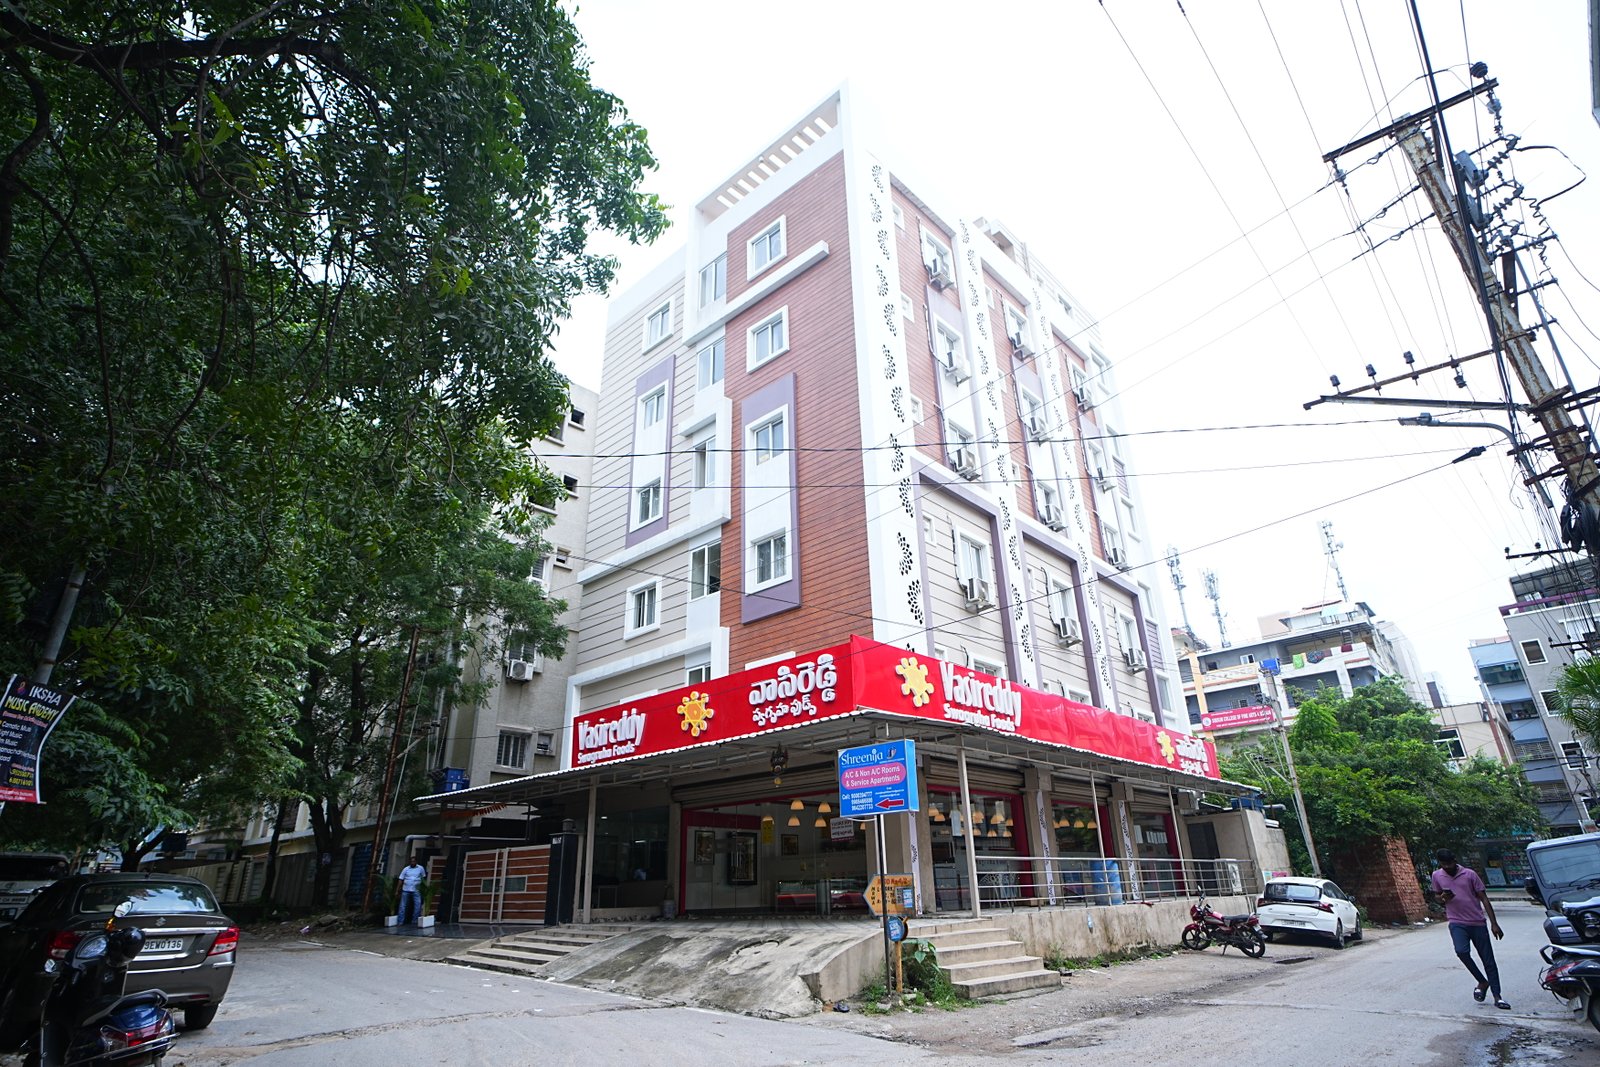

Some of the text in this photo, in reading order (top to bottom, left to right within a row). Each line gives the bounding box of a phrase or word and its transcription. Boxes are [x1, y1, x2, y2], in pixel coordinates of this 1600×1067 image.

[29, 685, 62, 706] IKSHA
[940, 660, 1021, 727] Vasireddy
[4, 695, 30, 712] MUSIC
[578, 708, 646, 750] Vasireddy
[991, 713, 1016, 731] Foods
[612, 741, 636, 757] Foods
[841, 748, 883, 766] Shreenija
[850, 779, 869, 787] Service
[870, 774, 900, 785] Apartments
[859, 769, 871, 777] Non
[881, 766, 900, 774] Rooms
